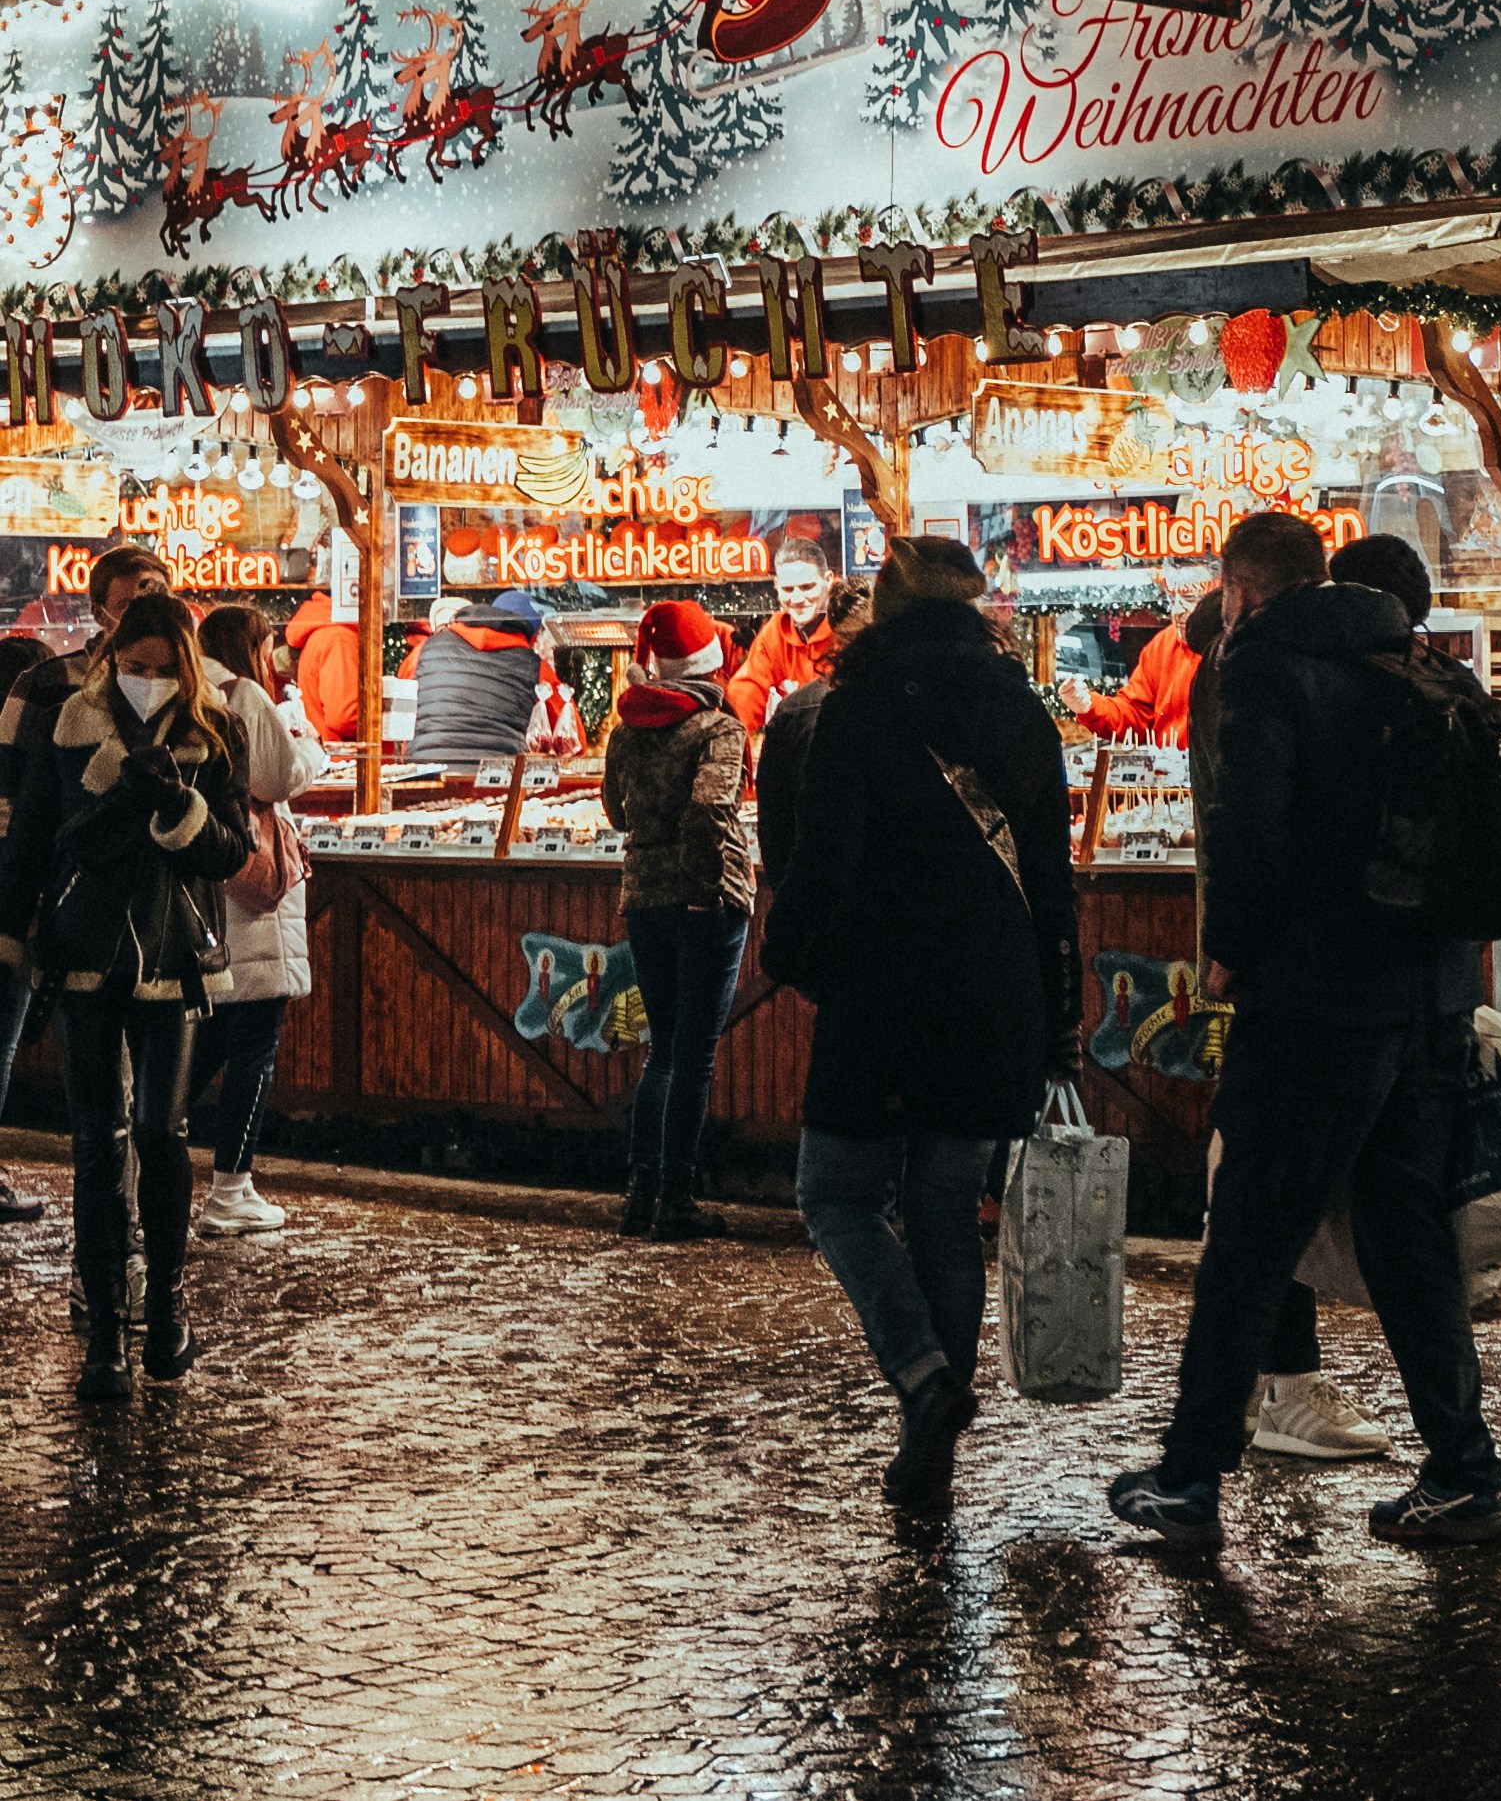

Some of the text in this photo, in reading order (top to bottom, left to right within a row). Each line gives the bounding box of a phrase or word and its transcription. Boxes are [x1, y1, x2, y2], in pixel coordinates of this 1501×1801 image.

[935, 37, 1383, 175] Weihnachten
[982, 396, 1090, 455] Ananas
[393, 431, 518, 486] Bananen
[1163, 433, 1314, 497] chtige
[117, 482, 241, 541] uchtige
[546, 466, 721, 524] chtige
[498, 528, 769, 582] Köstlichkeiten
[1039, 502, 1364, 560] Köstlichken
[49, 545, 279, 592] Köhkeiten
